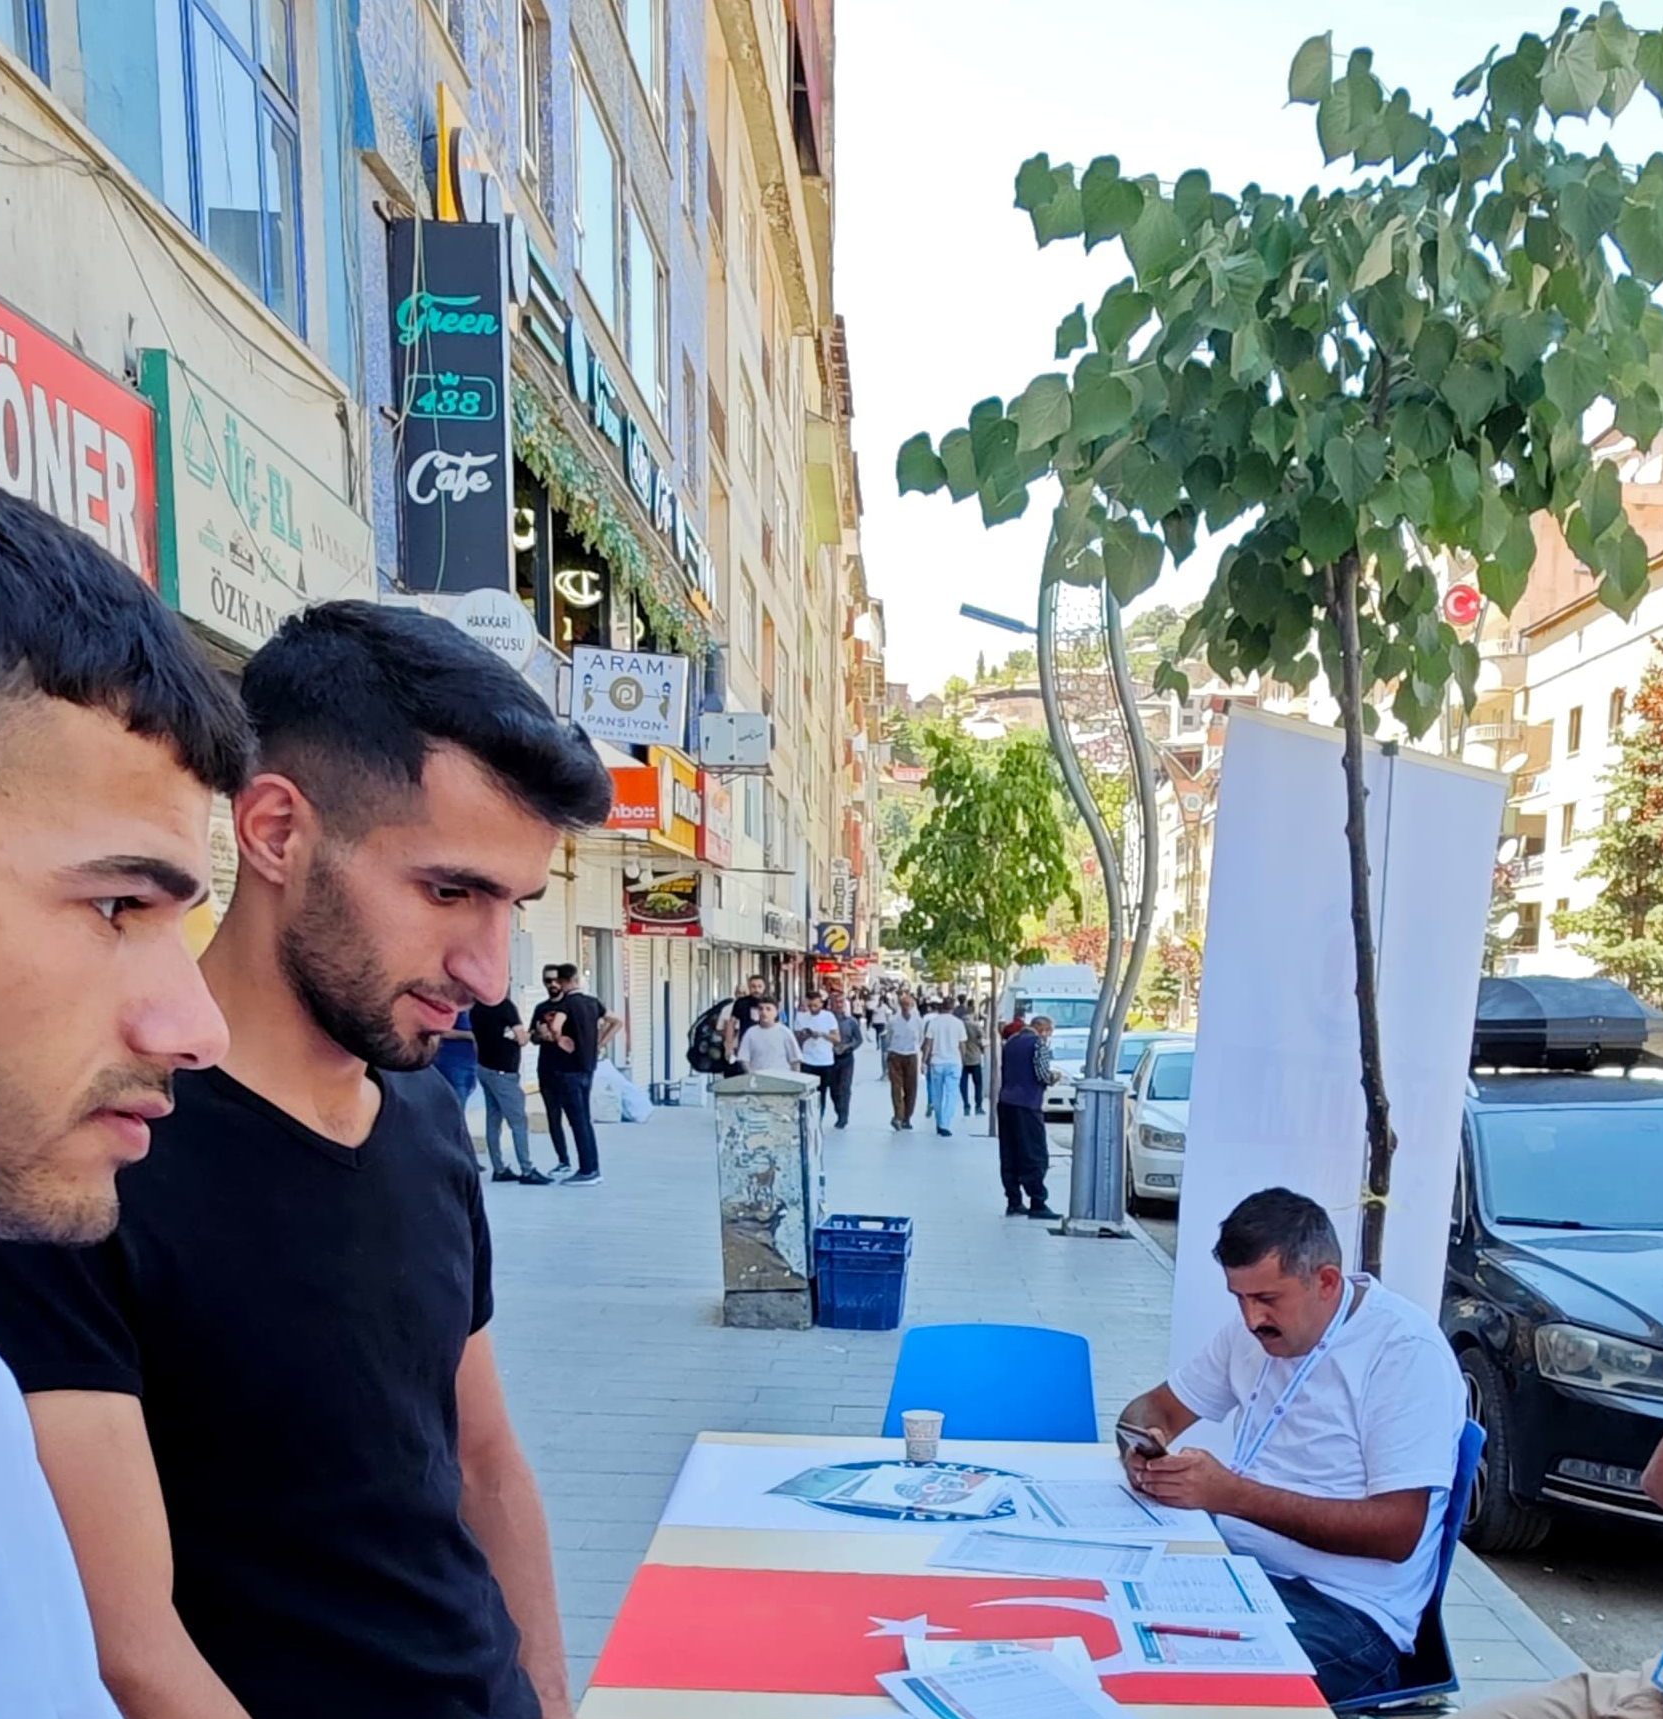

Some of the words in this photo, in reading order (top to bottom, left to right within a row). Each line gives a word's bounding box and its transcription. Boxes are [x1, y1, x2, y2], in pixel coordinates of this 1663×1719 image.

[396, 291, 499, 345] Green
[416, 390, 481, 414] 438
[406, 450, 498, 504] Cafe
[467, 615, 512, 629] HAKKARİ
[590, 654, 666, 676] ARAM
[588, 714, 663, 732] PANSİYON
